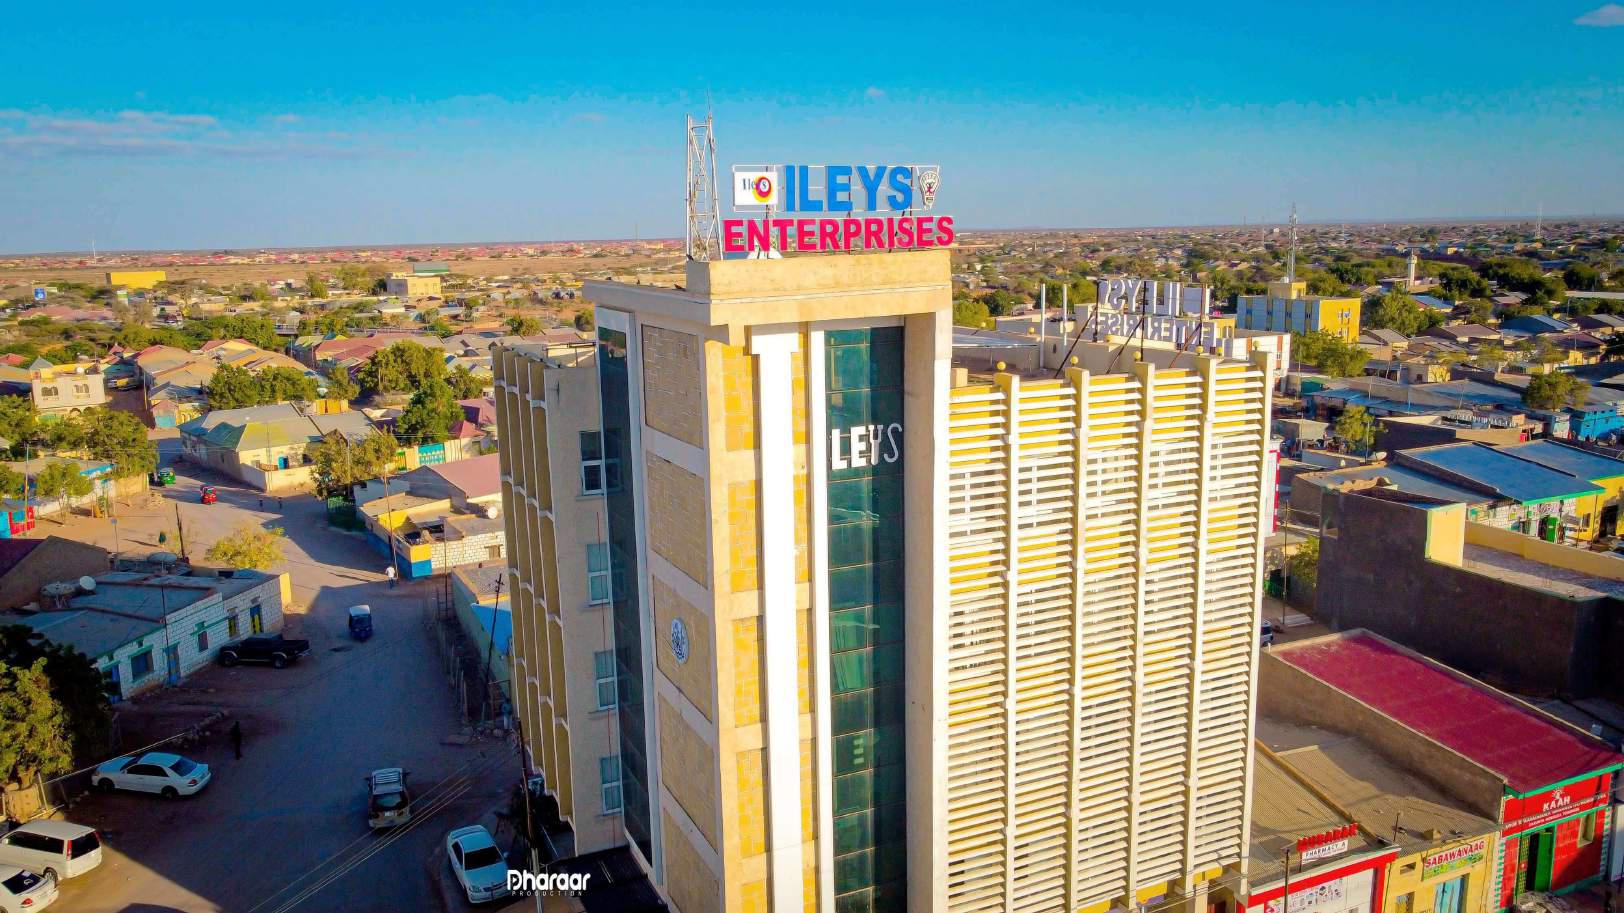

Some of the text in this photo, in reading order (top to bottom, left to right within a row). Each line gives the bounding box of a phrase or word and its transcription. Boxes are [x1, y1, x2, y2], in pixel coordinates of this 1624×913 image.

[784, 165, 913, 212] ILEYS
[723, 215, 954, 253] ENTERPRISES
[1542, 796, 1571, 812] KAAH
